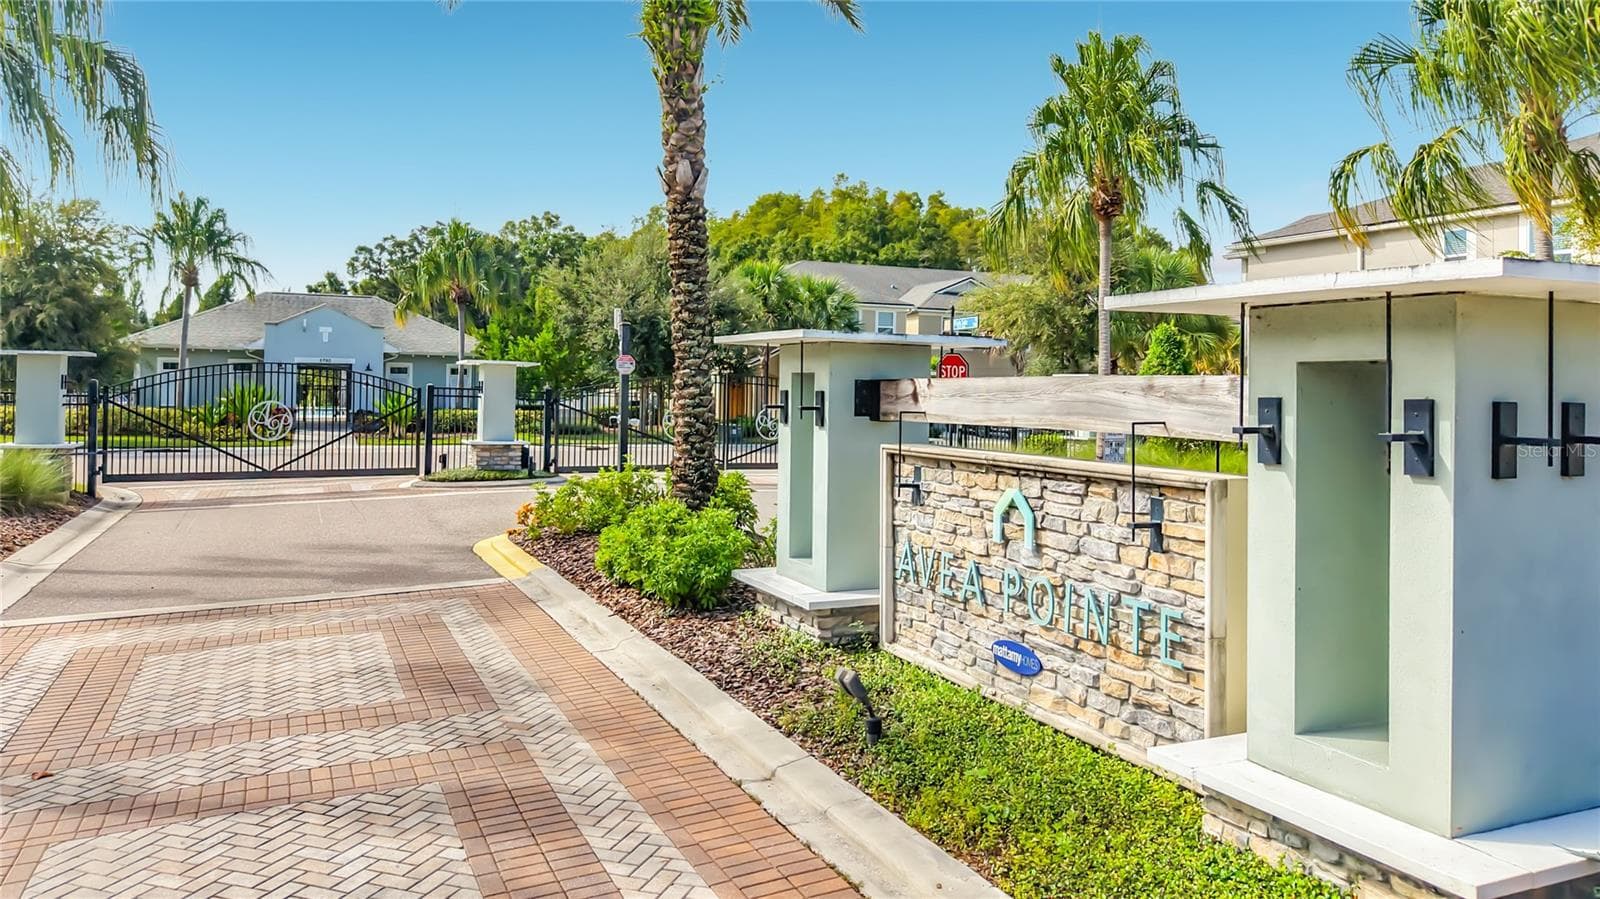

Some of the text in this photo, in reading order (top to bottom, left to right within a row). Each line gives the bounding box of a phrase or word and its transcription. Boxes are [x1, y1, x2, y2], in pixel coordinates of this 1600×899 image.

[941, 365, 965, 378] STOP
[895, 540, 1184, 670] AVEA POINTE
